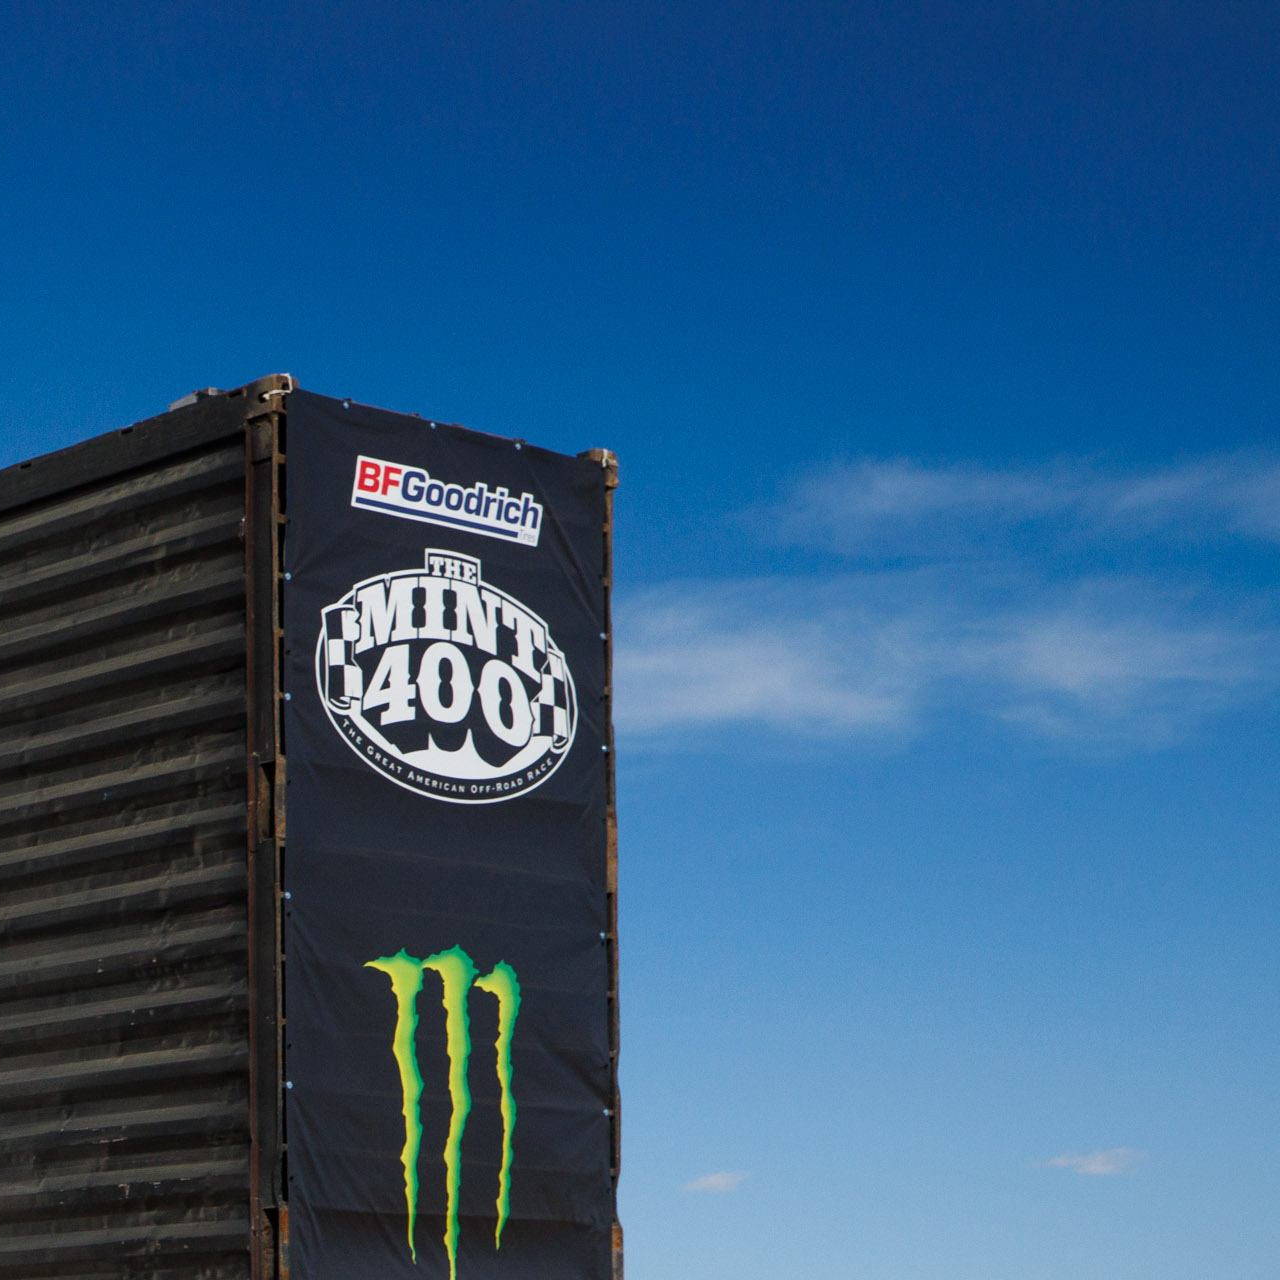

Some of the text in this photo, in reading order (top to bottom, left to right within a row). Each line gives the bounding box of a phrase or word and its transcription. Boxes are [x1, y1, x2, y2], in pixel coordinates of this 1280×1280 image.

[357, 460, 539, 529] BFGoodrich
[429, 556, 477, 582] THE
[355, 576, 546, 684] MINT
[362, 641, 535, 747] 400
[342, 718, 553, 794] THE GREAT AMERICAN OFF-ROAD RACE
